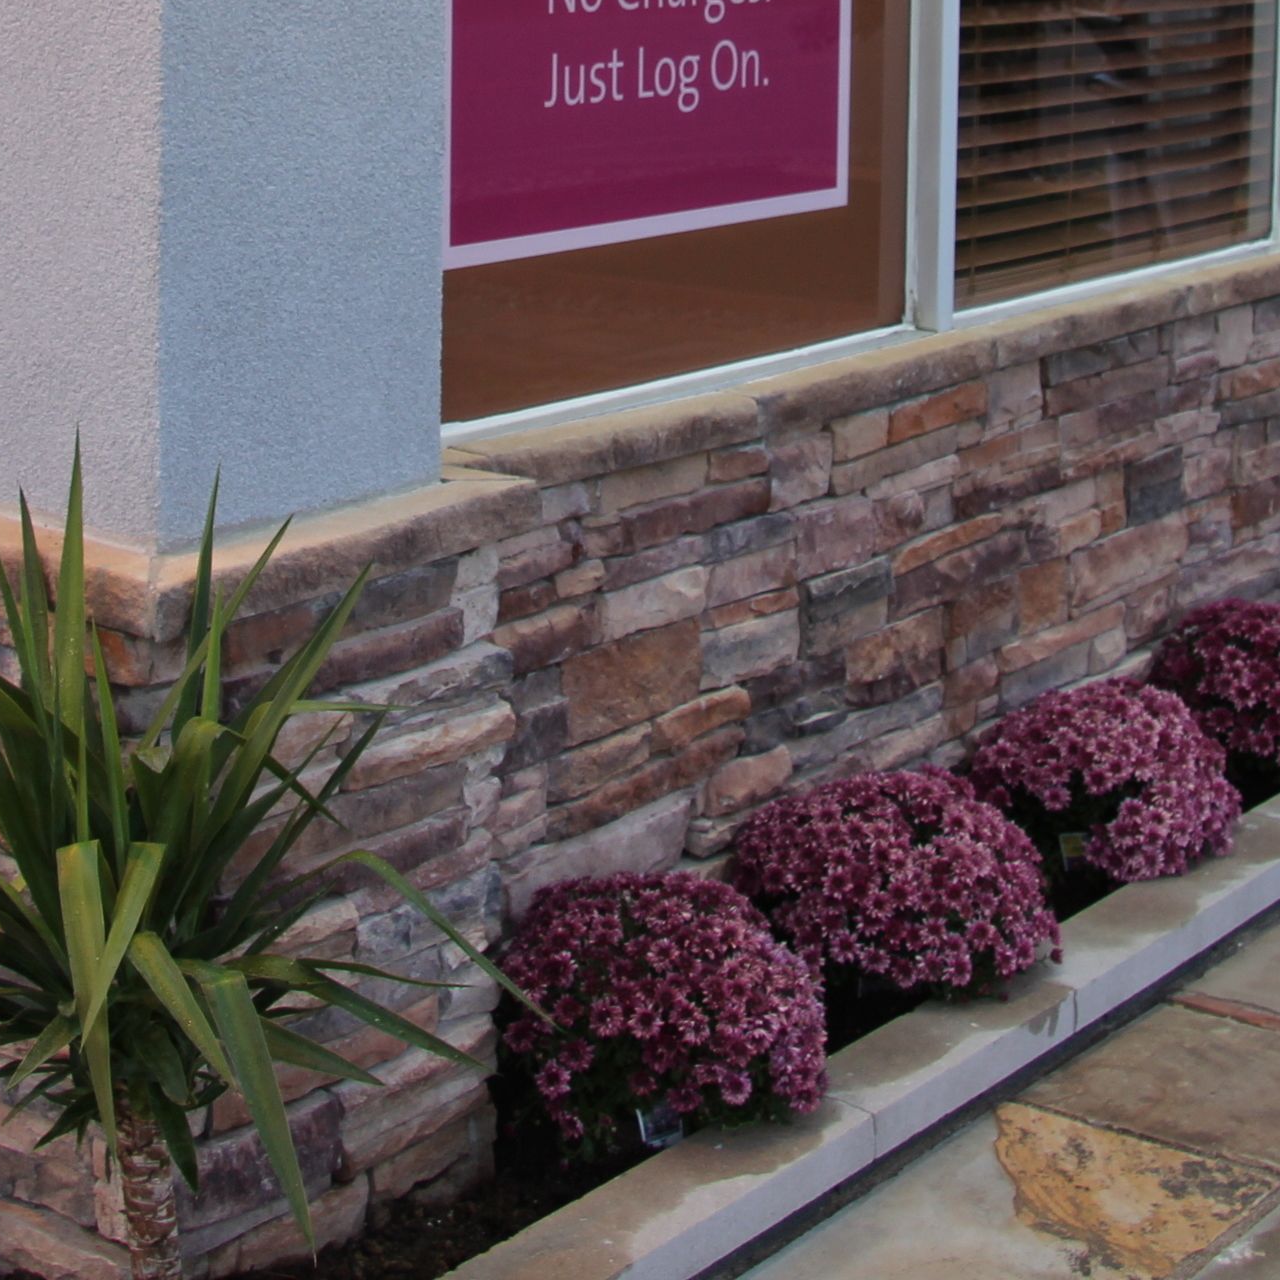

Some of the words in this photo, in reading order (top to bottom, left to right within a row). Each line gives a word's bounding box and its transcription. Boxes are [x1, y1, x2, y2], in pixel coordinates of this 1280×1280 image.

[544, 48, 624, 108] Just
[638, 46, 700, 113] Log
[710, 39, 769, 91] On.
